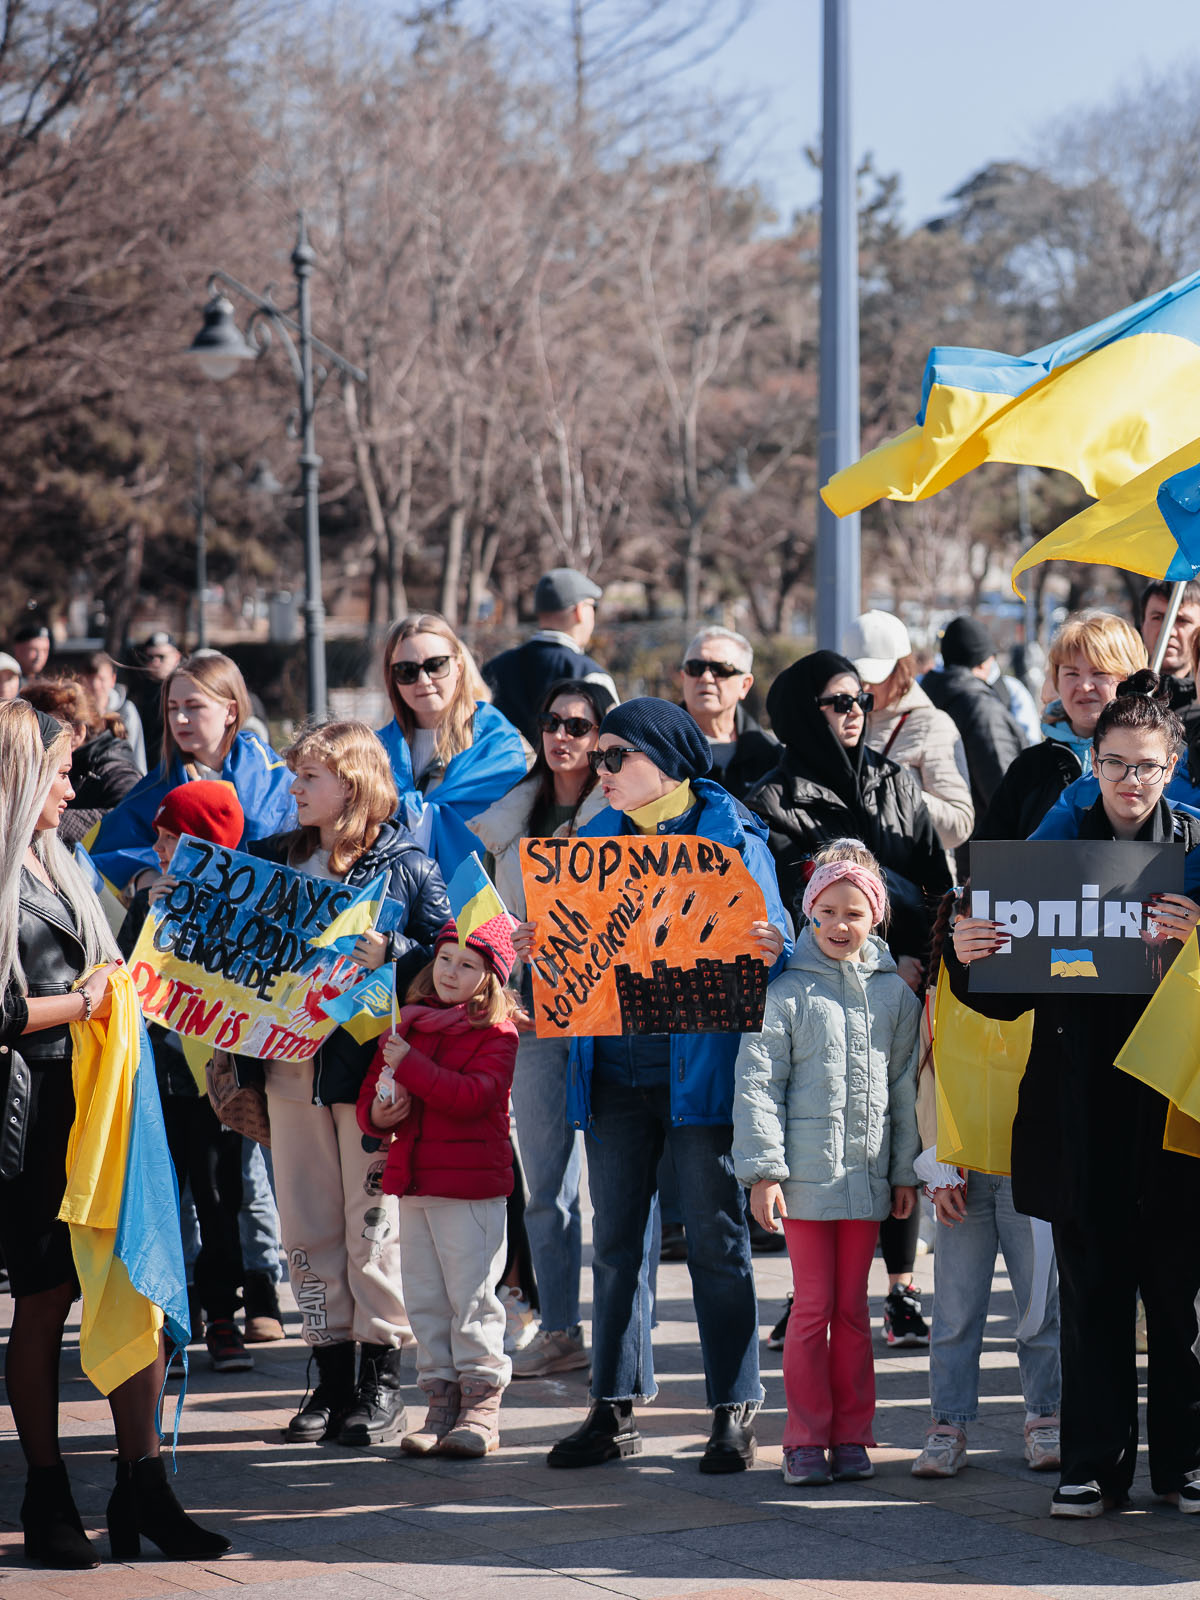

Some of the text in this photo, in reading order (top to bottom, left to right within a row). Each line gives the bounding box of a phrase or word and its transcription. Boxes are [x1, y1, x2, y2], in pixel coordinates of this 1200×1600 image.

[187, 840, 353, 932] 730 DAYS
[526, 839, 622, 892] STOP
[165, 880, 213, 923] OF
